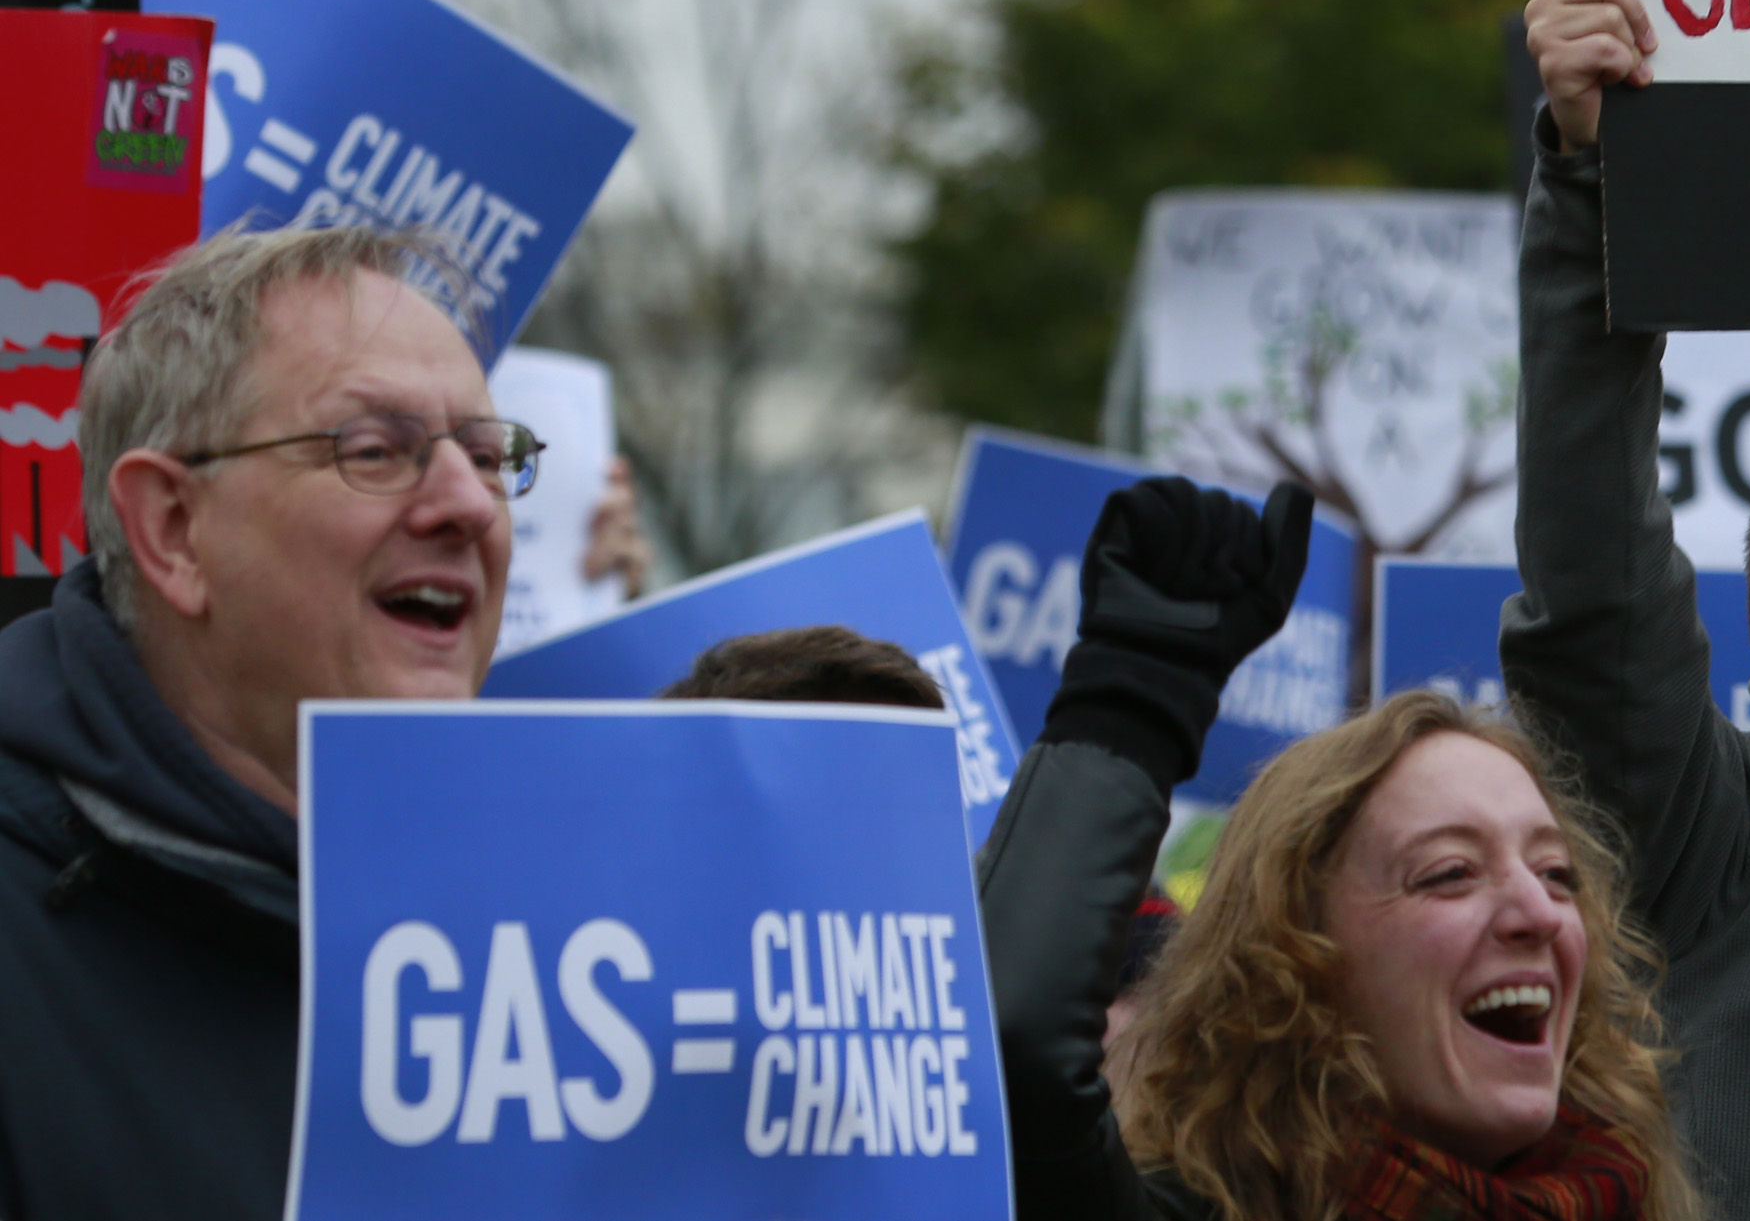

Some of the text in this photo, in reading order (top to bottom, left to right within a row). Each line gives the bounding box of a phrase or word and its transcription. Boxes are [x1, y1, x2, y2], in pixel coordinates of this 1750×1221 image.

[325, 113, 542, 294] CLIMATE
[360, 916, 655, 1148] GAS
[751, 910, 965, 1032] CLIMATE
[744, 1033, 977, 1159] CHANGE
